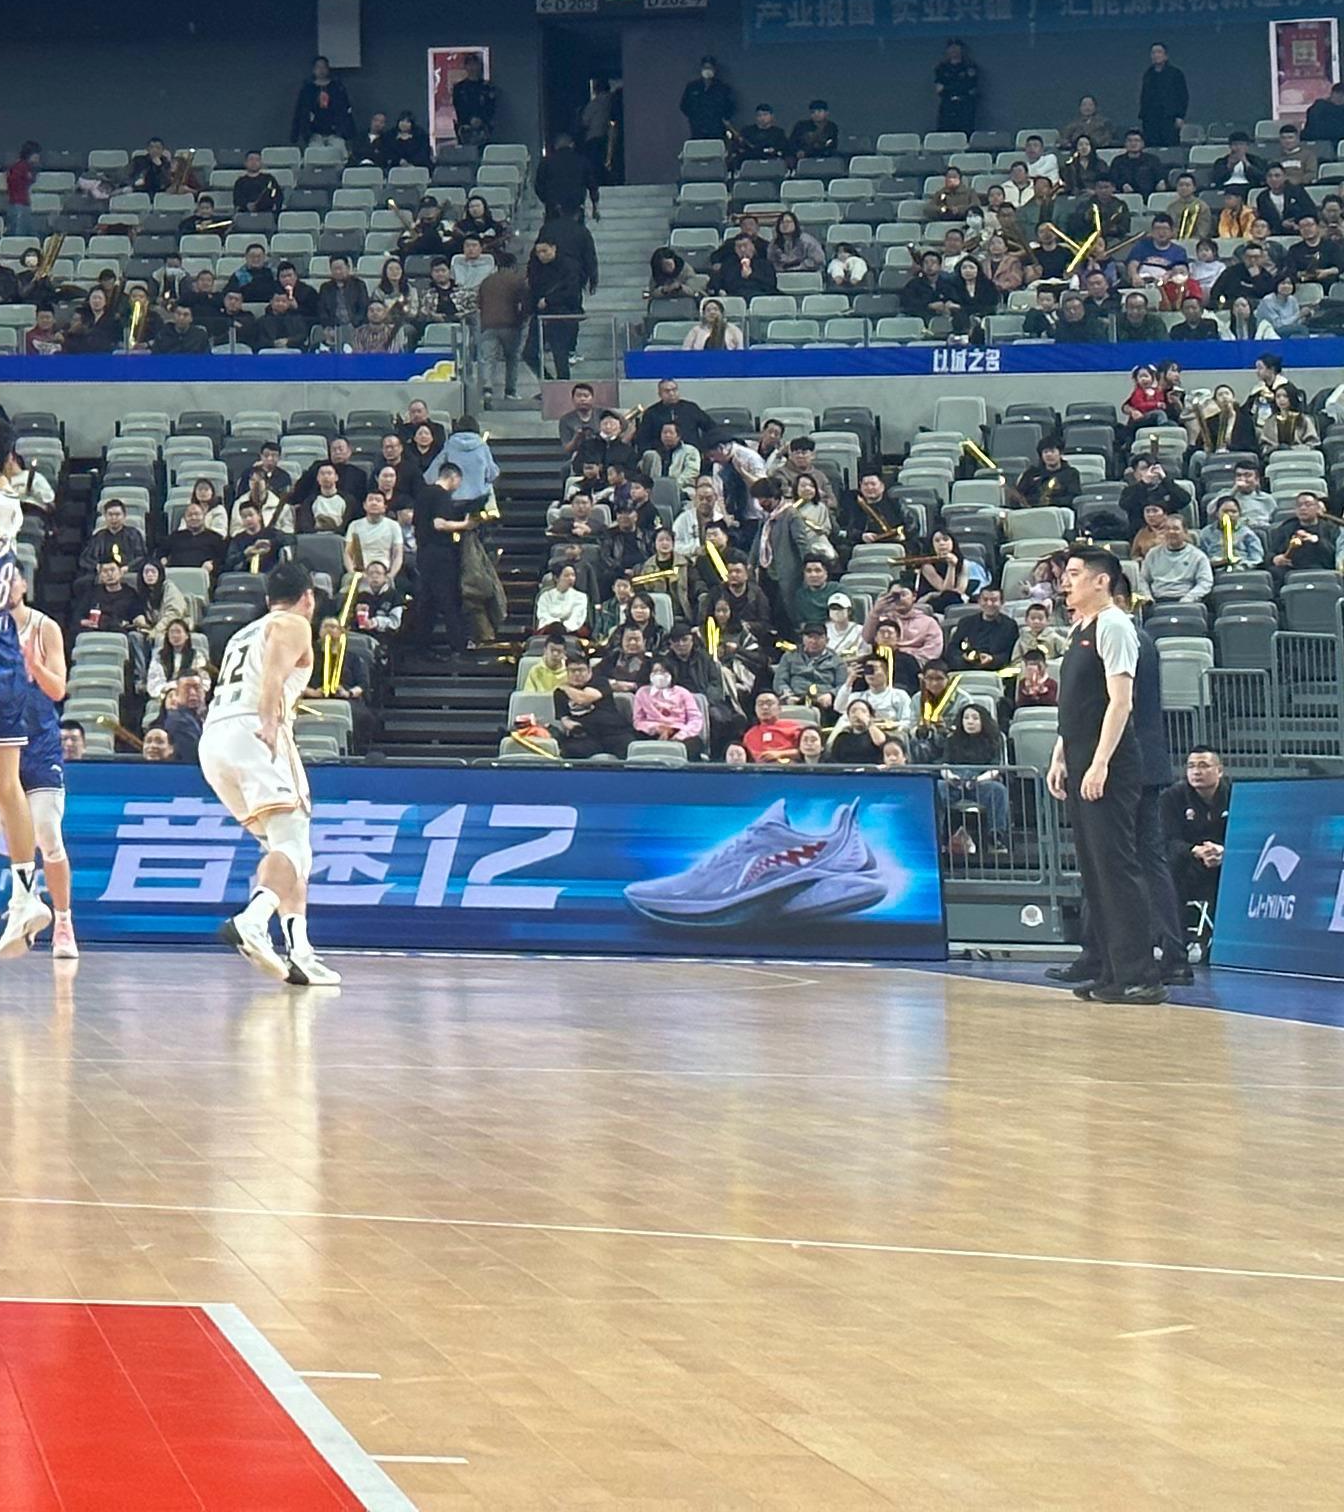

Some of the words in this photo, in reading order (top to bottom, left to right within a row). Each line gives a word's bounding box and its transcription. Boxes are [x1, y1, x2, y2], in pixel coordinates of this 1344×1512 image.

[933, 348, 1000, 372] 以城之名
[1247, 892, 1297, 920] LI-NING
